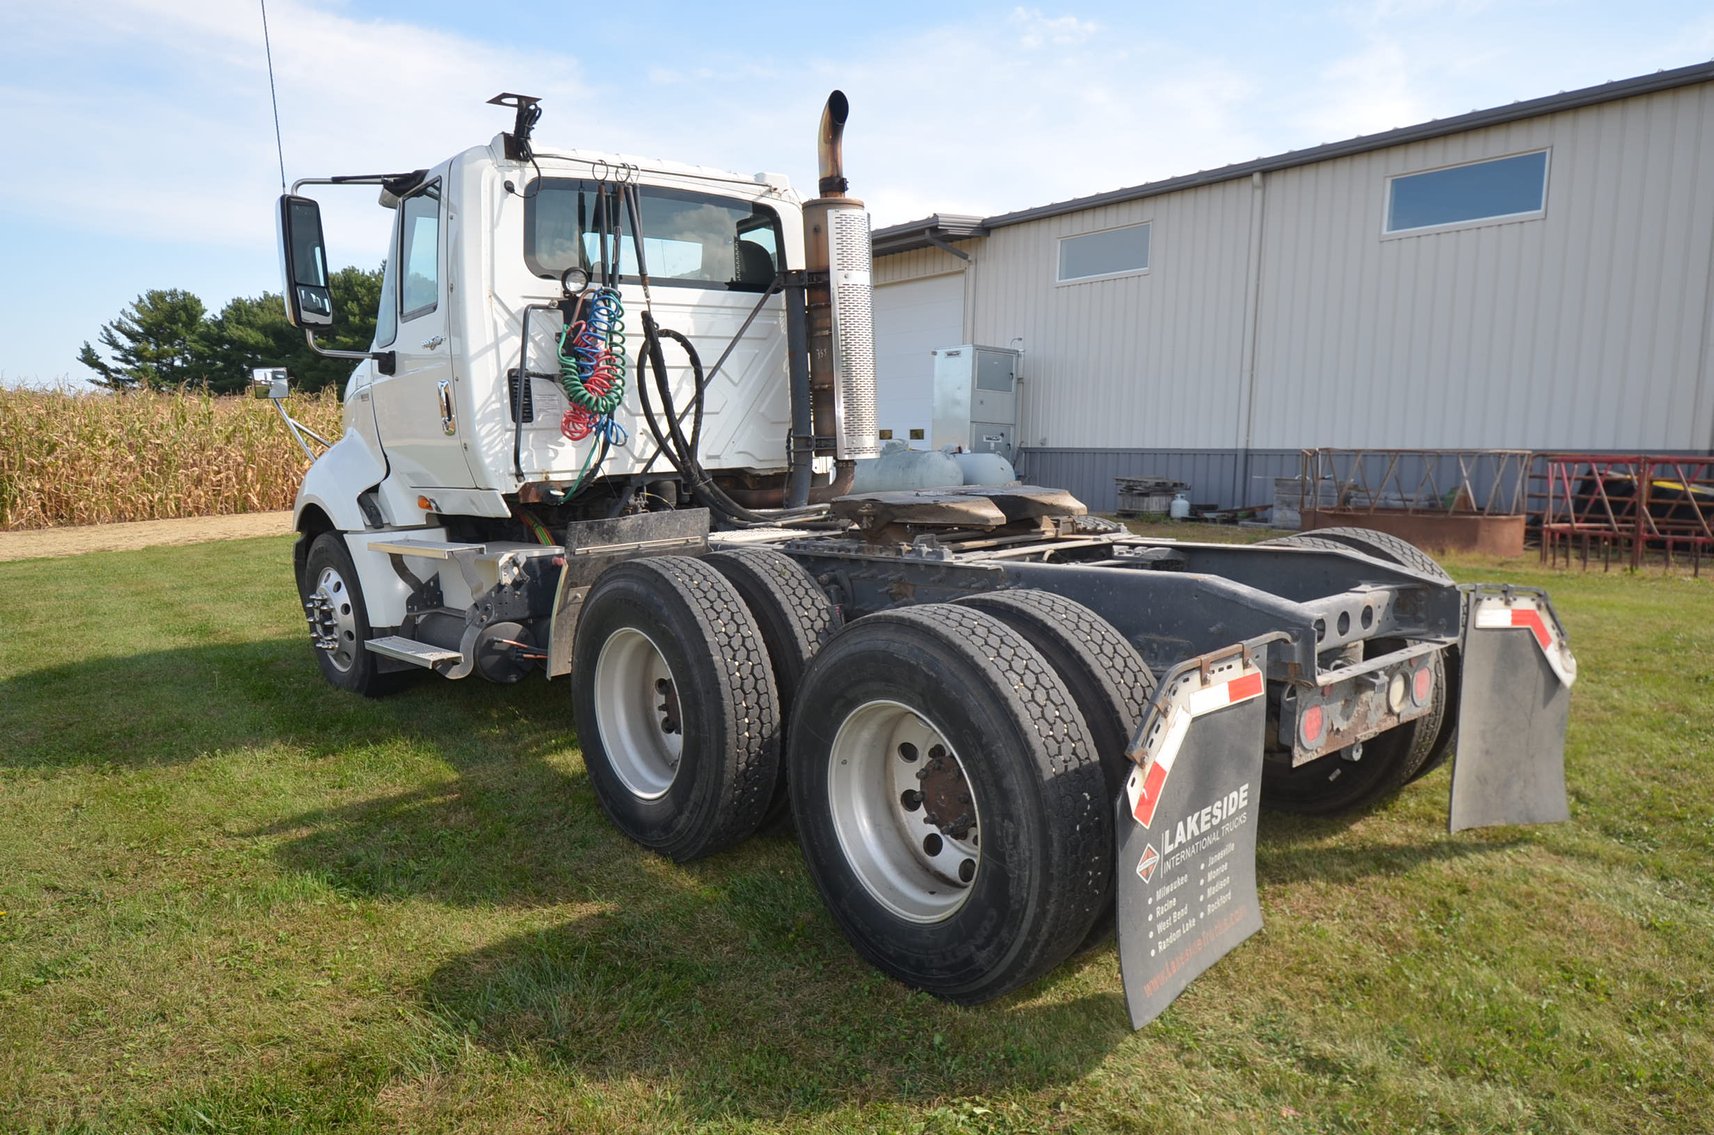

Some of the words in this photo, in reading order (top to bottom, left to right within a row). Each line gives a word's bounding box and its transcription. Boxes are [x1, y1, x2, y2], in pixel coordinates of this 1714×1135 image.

[1164, 783, 1249, 855] LAKESIDE
[1163, 830, 1220, 874] INTERNATIONAL
[1221, 812, 1247, 837] TRUCKS
[1208, 842, 1235, 867] Janesville
[1208, 862, 1228, 882] Monroe
[1156, 874, 1188, 901] Milwaukee
[1207, 876, 1230, 899] Madison
[1156, 897, 1176, 918] Racine
[1207, 889, 1231, 915] Rockford
[1157, 916, 1172, 934] West
[1173, 904, 1188, 923] Bend
[1158, 929, 1181, 953] Random
[1182, 918, 1196, 934] Lake
